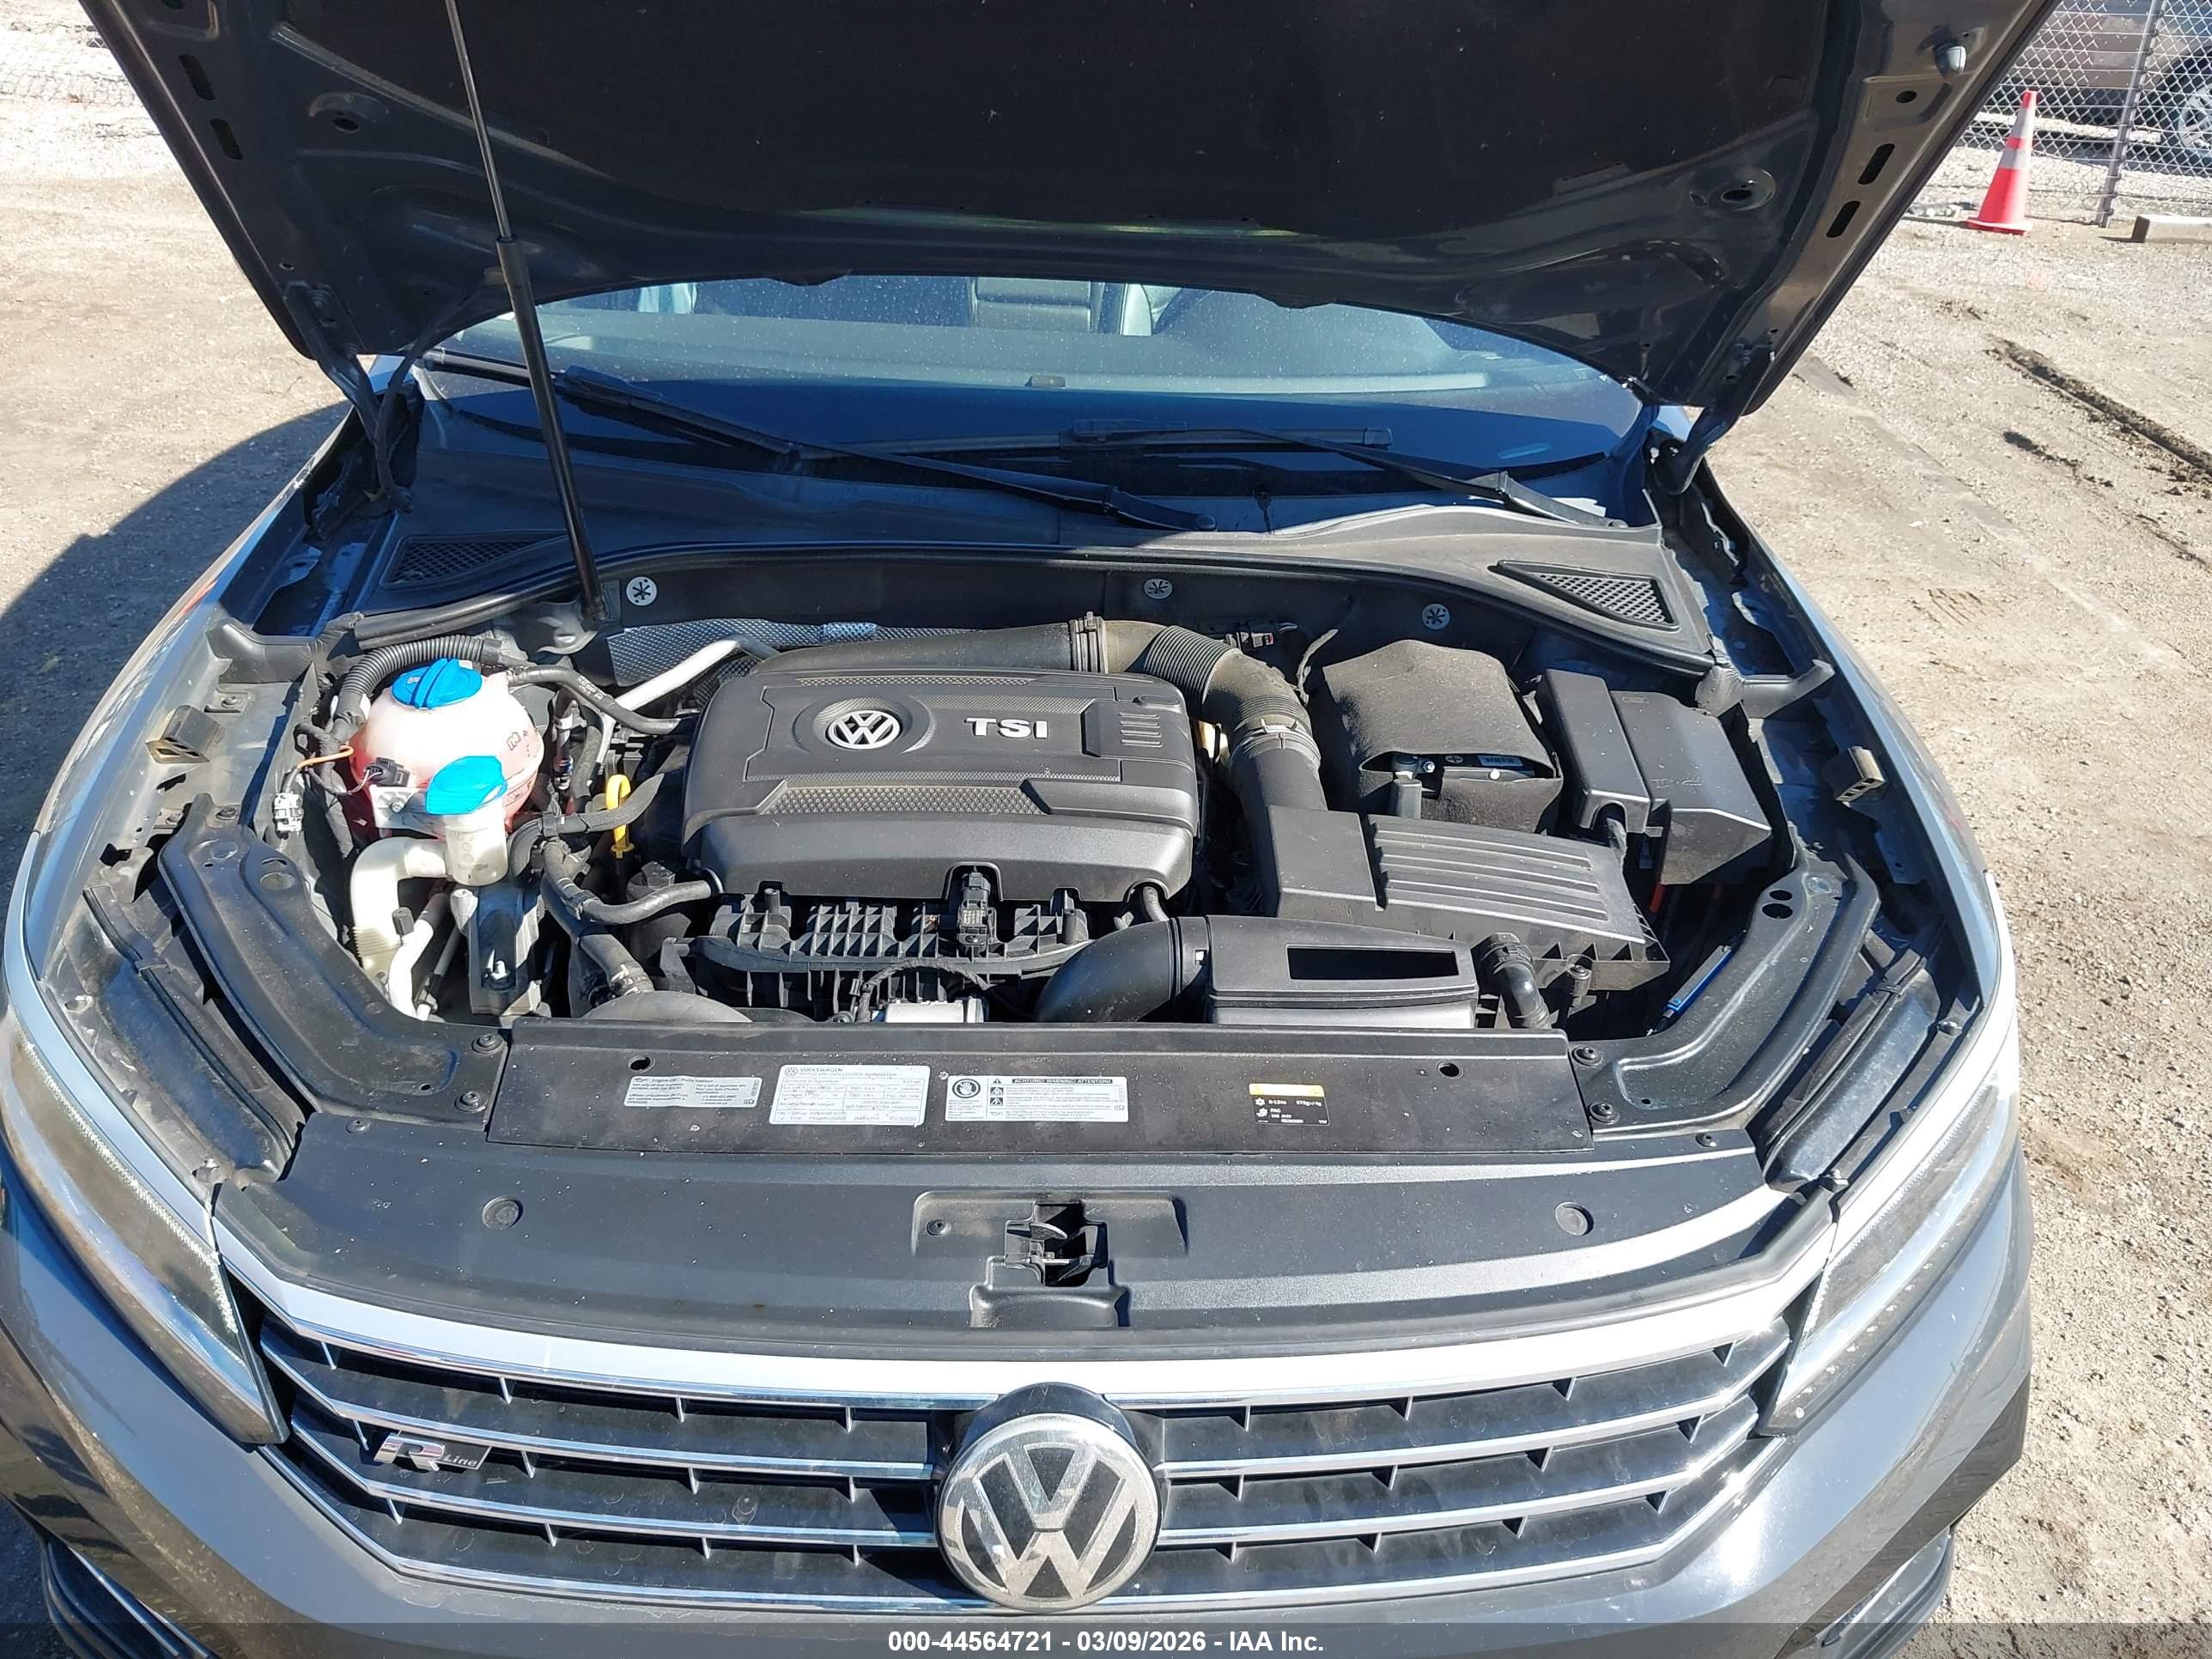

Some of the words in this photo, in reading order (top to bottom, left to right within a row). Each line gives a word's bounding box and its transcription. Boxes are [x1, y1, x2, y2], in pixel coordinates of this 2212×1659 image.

[963, 717, 1048, 739] TSI
[374, 1435, 446, 1472] R
[442, 1453, 479, 1468] Line
